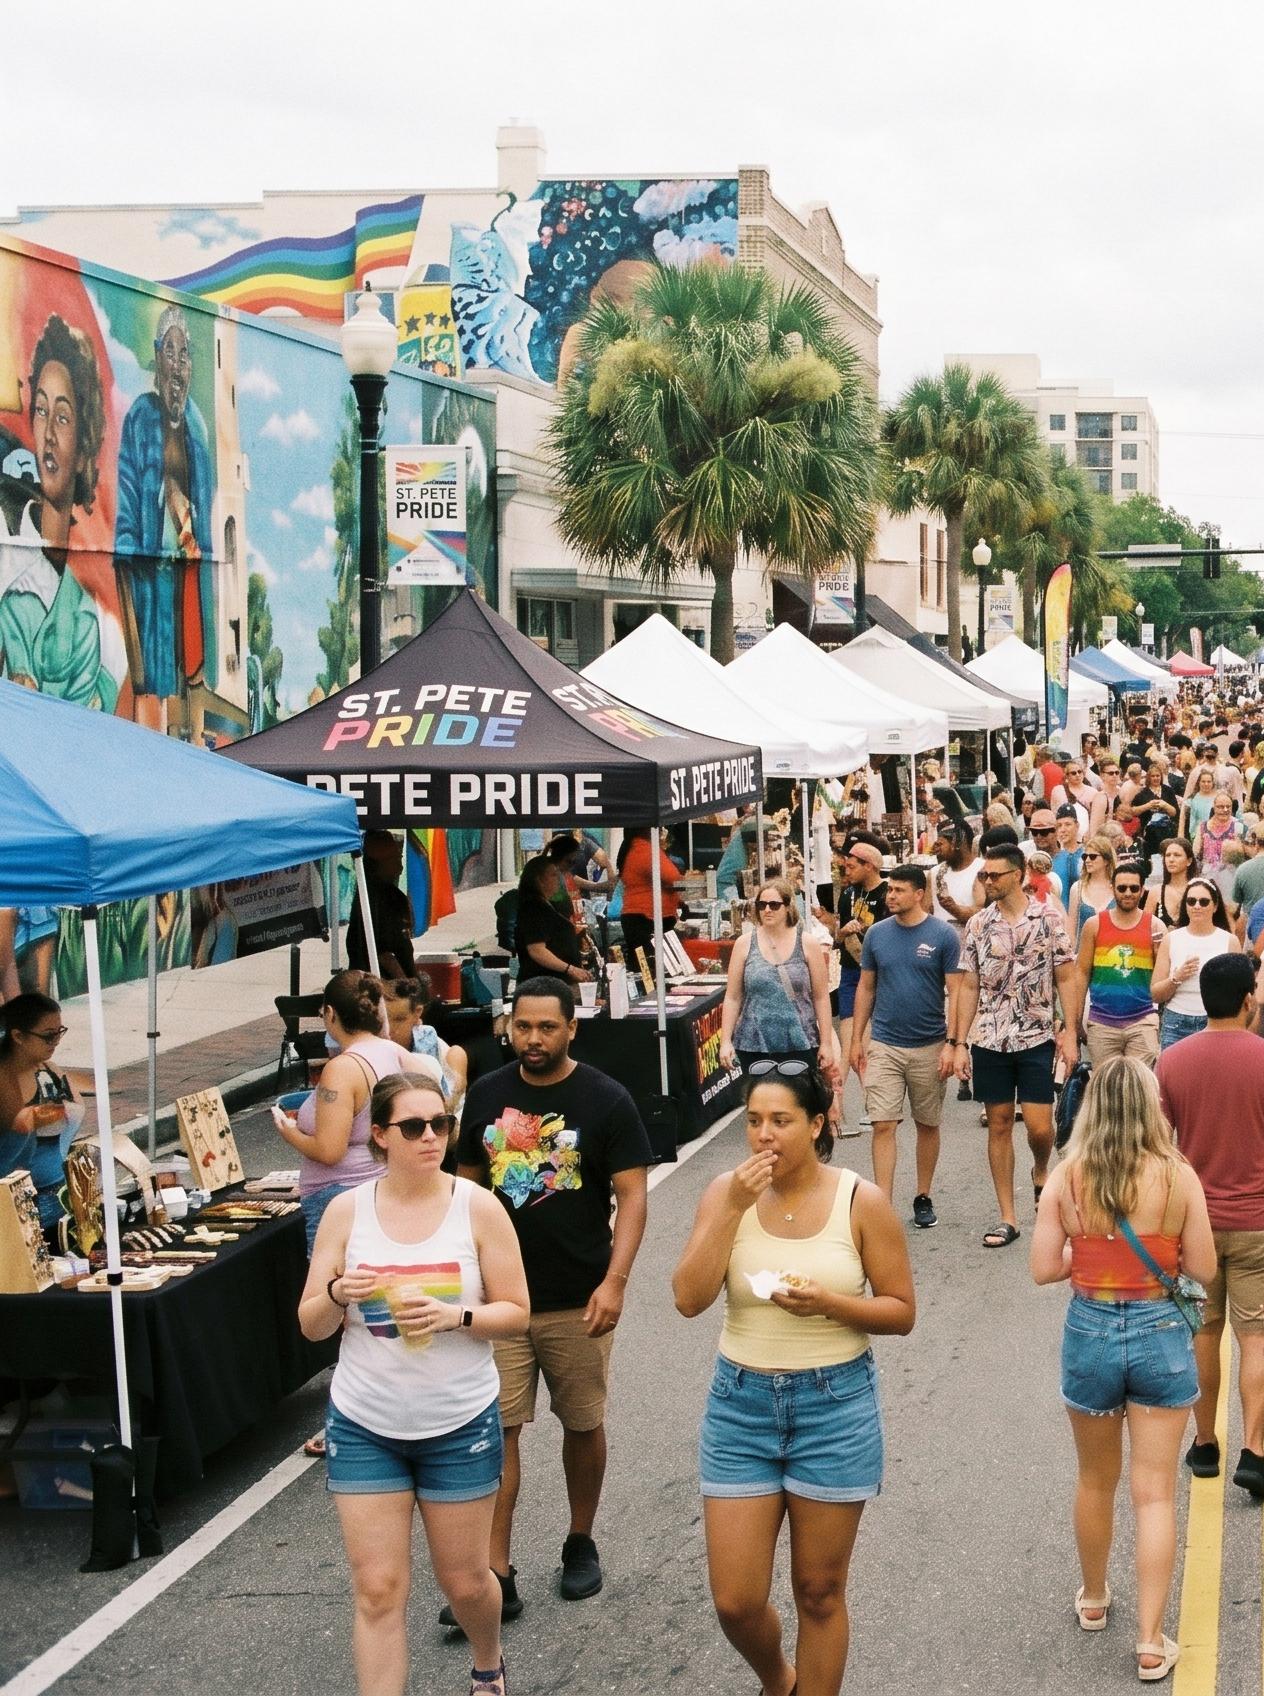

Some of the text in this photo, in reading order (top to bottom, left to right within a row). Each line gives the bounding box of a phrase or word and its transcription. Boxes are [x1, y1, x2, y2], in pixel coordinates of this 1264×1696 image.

[396, 487, 456, 499] ST. PETE
[396, 502, 458, 519] PRIDE
[338, 684, 532, 719] ST. PETE
[322, 713, 523, 751] PRIDE
[450, 773, 603, 816] PRIDE
[670, 756, 757, 811] ST. PETE PRIDE
